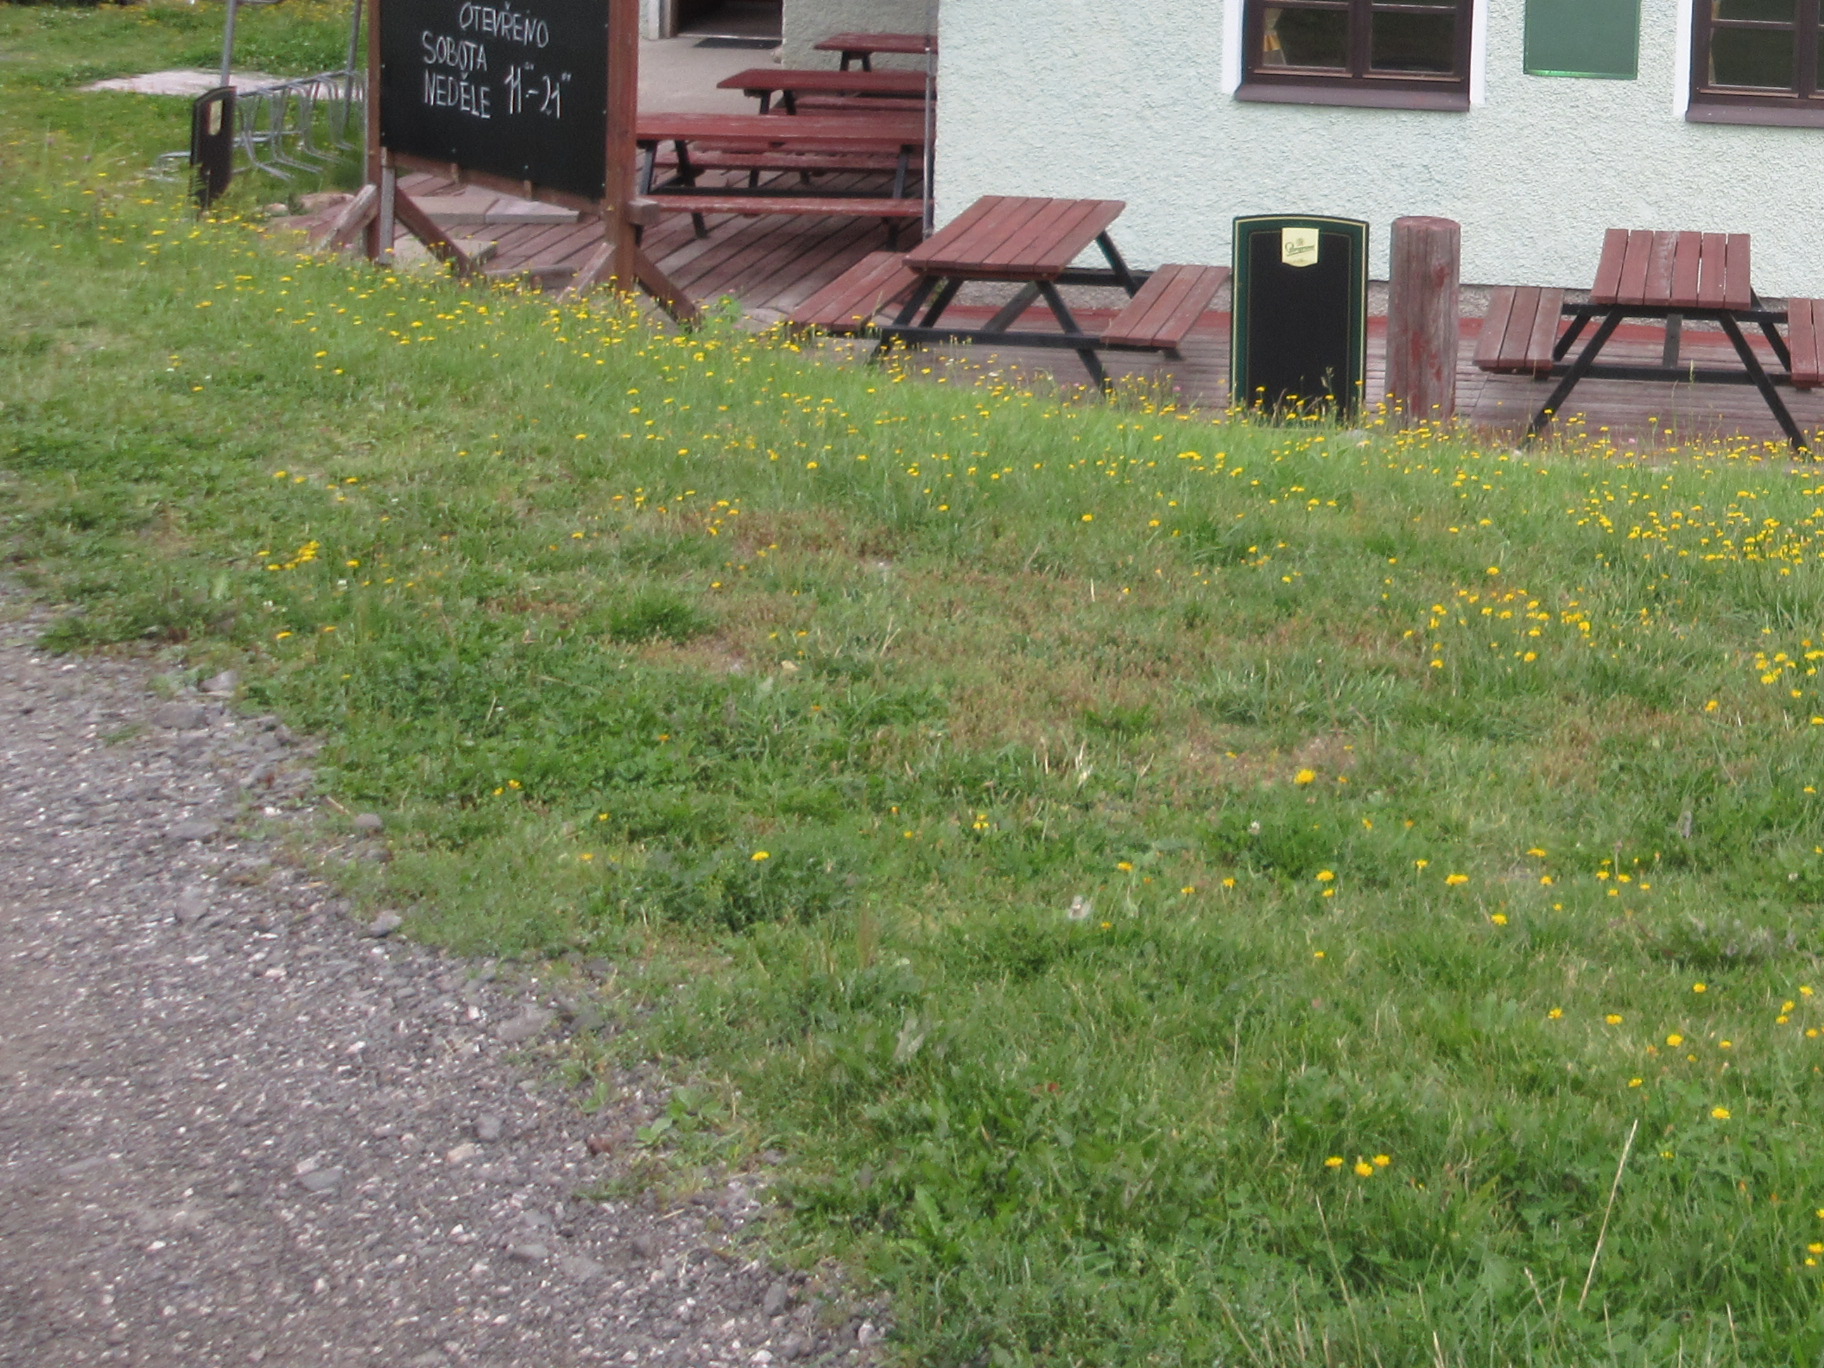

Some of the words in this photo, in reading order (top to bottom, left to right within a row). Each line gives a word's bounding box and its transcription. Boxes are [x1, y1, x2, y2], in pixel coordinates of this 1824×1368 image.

[459, 1, 549, 48] OTEVŘENO
[422, 31, 488, 71] SOBOTA
[424, 69, 491, 119] NEDĚLE
